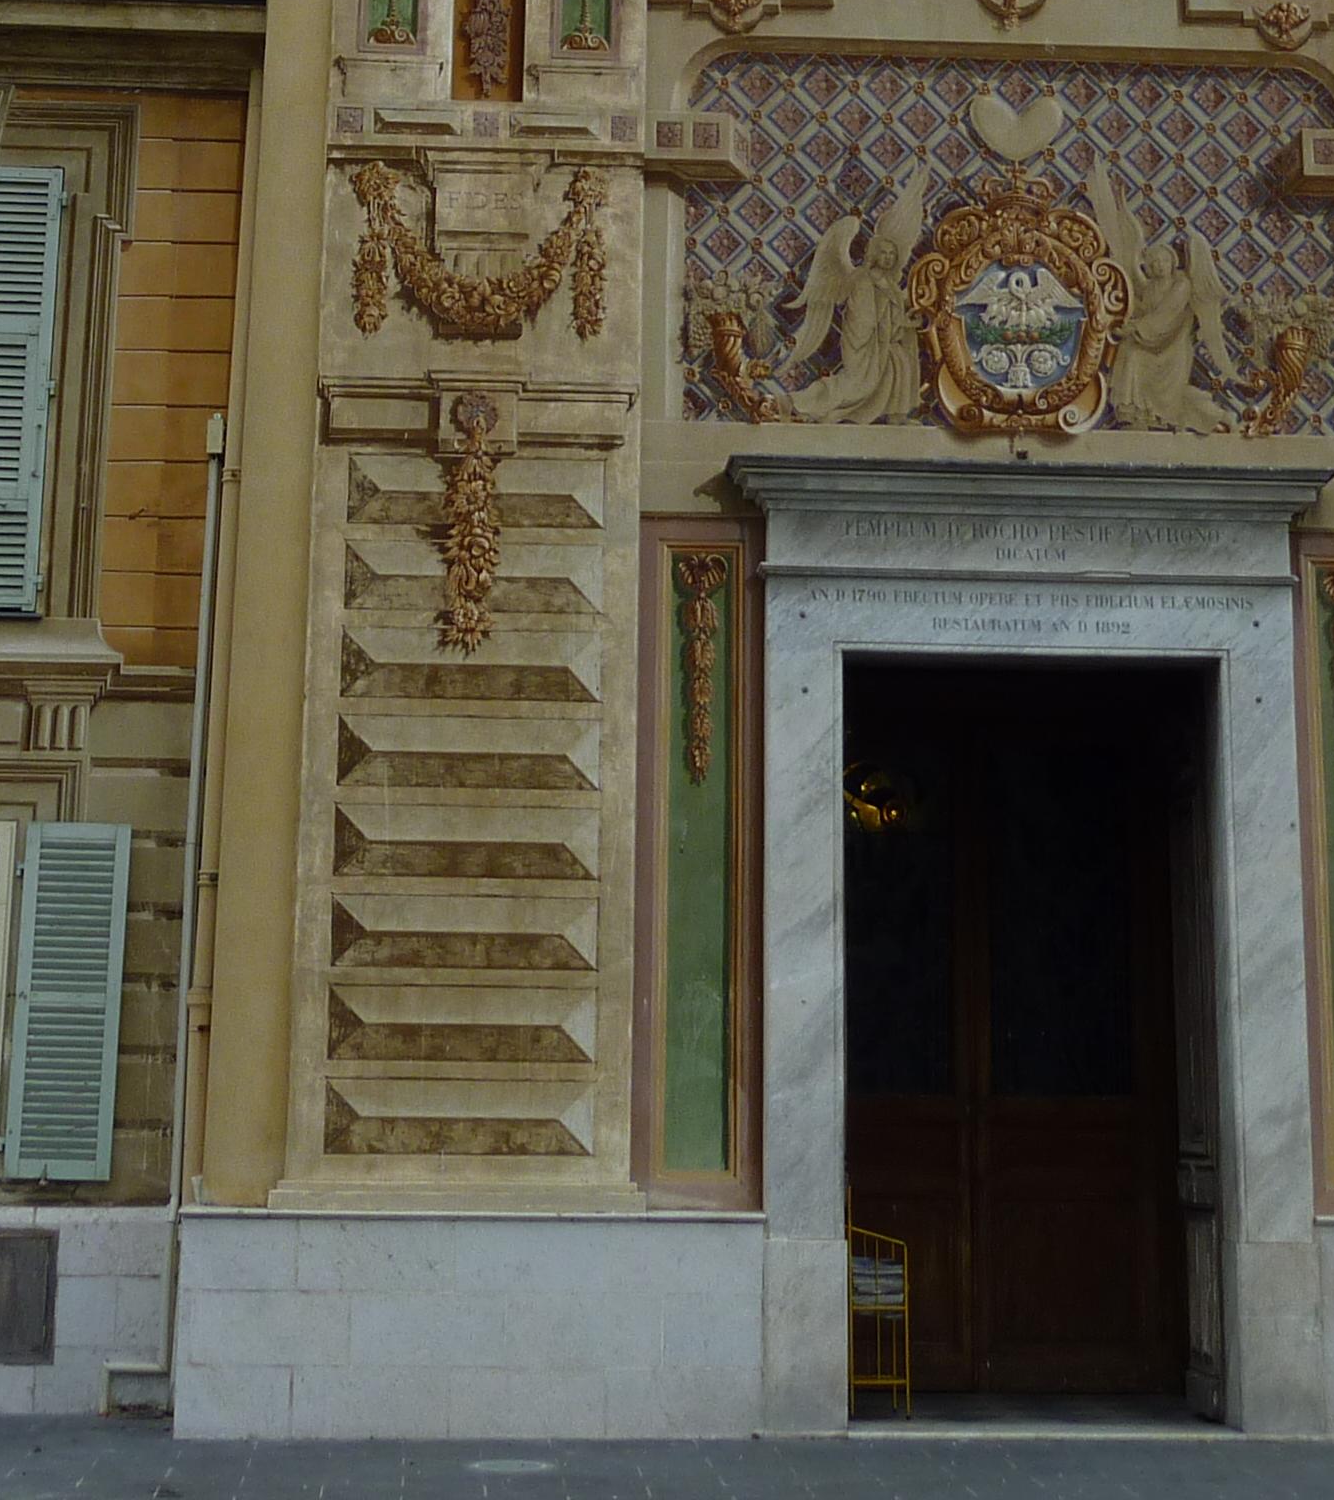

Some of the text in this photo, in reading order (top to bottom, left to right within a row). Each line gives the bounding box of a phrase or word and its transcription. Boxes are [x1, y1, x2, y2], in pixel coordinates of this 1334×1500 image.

[842, 520, 937, 538] TEMPLUM
[971, 522, 1039, 541] ROCHO
[1129, 526, 1221, 545] PATRONO
[995, 547, 1066, 562] DICATUM
[893, 589, 963, 605] ERECTUM
[969, 591, 1016, 607] OPERE
[1023, 592, 1042, 607] ET
[1085, 594, 1154, 610] FIDELIUM
[931, 616, 1043, 633] RESTAURATUM
[1095, 619, 1131, 635] 1892
